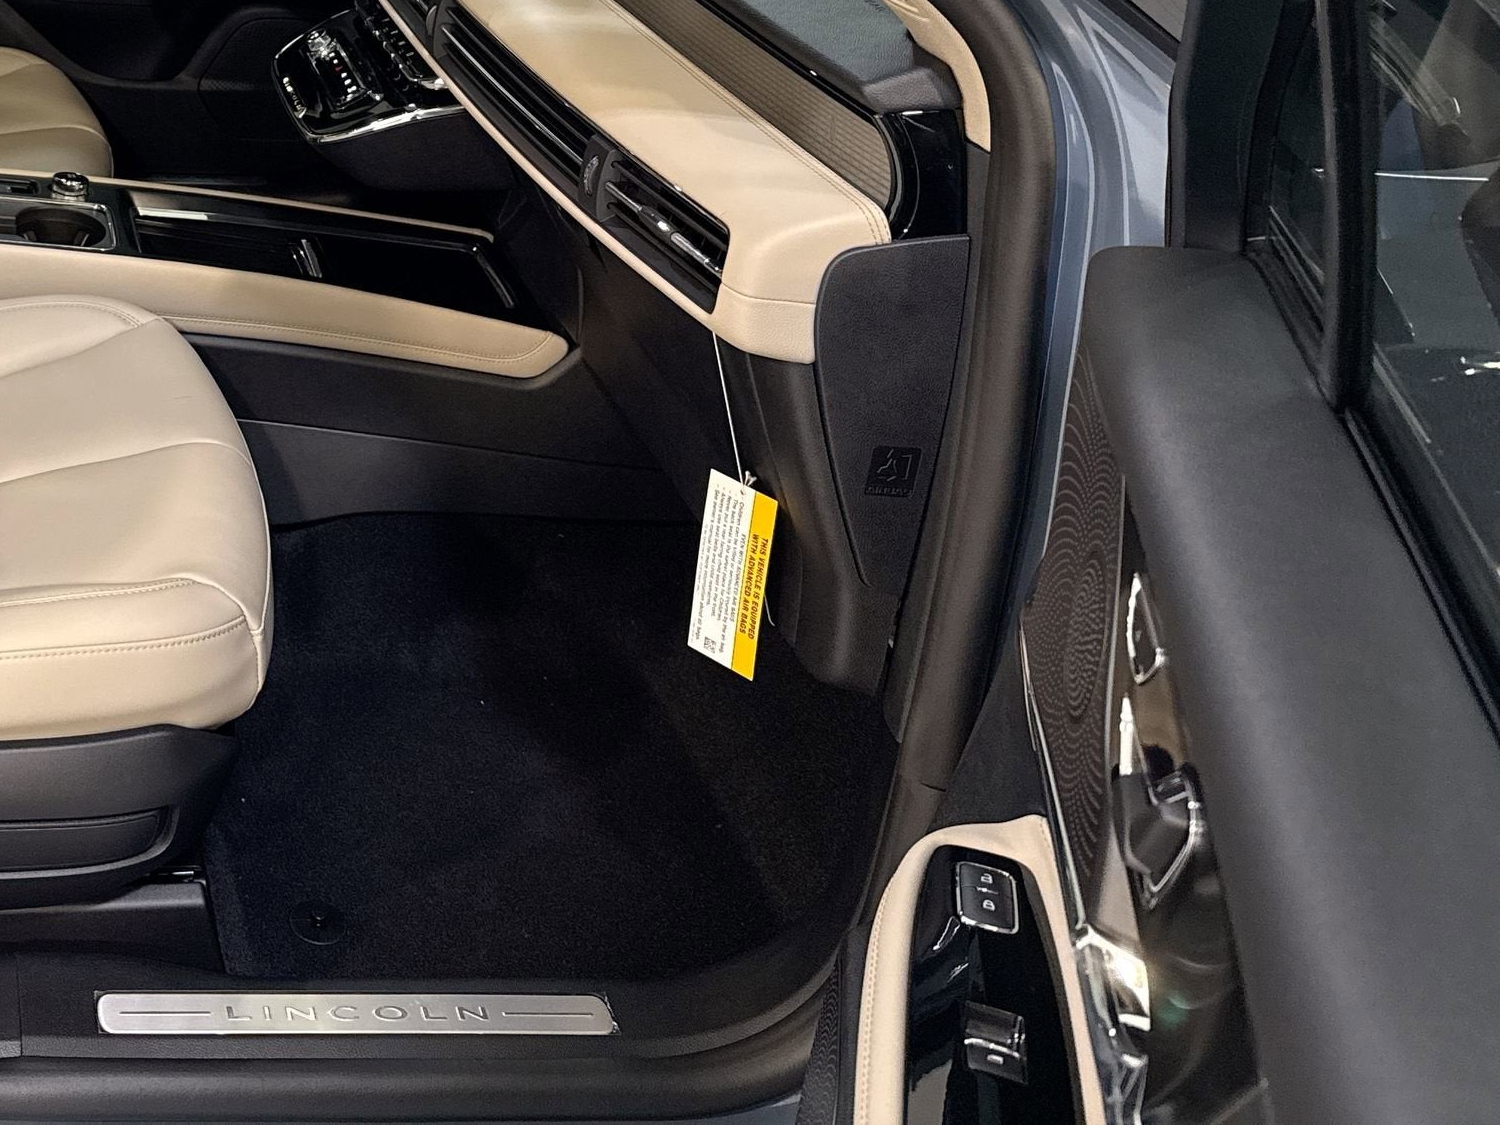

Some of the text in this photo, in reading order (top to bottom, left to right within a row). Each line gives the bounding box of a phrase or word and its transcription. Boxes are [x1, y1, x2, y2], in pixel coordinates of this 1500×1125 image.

[759, 536, 768, 556] THIS
[739, 532, 759, 634] WITH ADVANCED AIR BAGS
[754, 556, 765, 591] VEHICLE
[747, 600, 759, 640] EQUIPPED
[225, 1005, 490, 1021] LINCOLN
